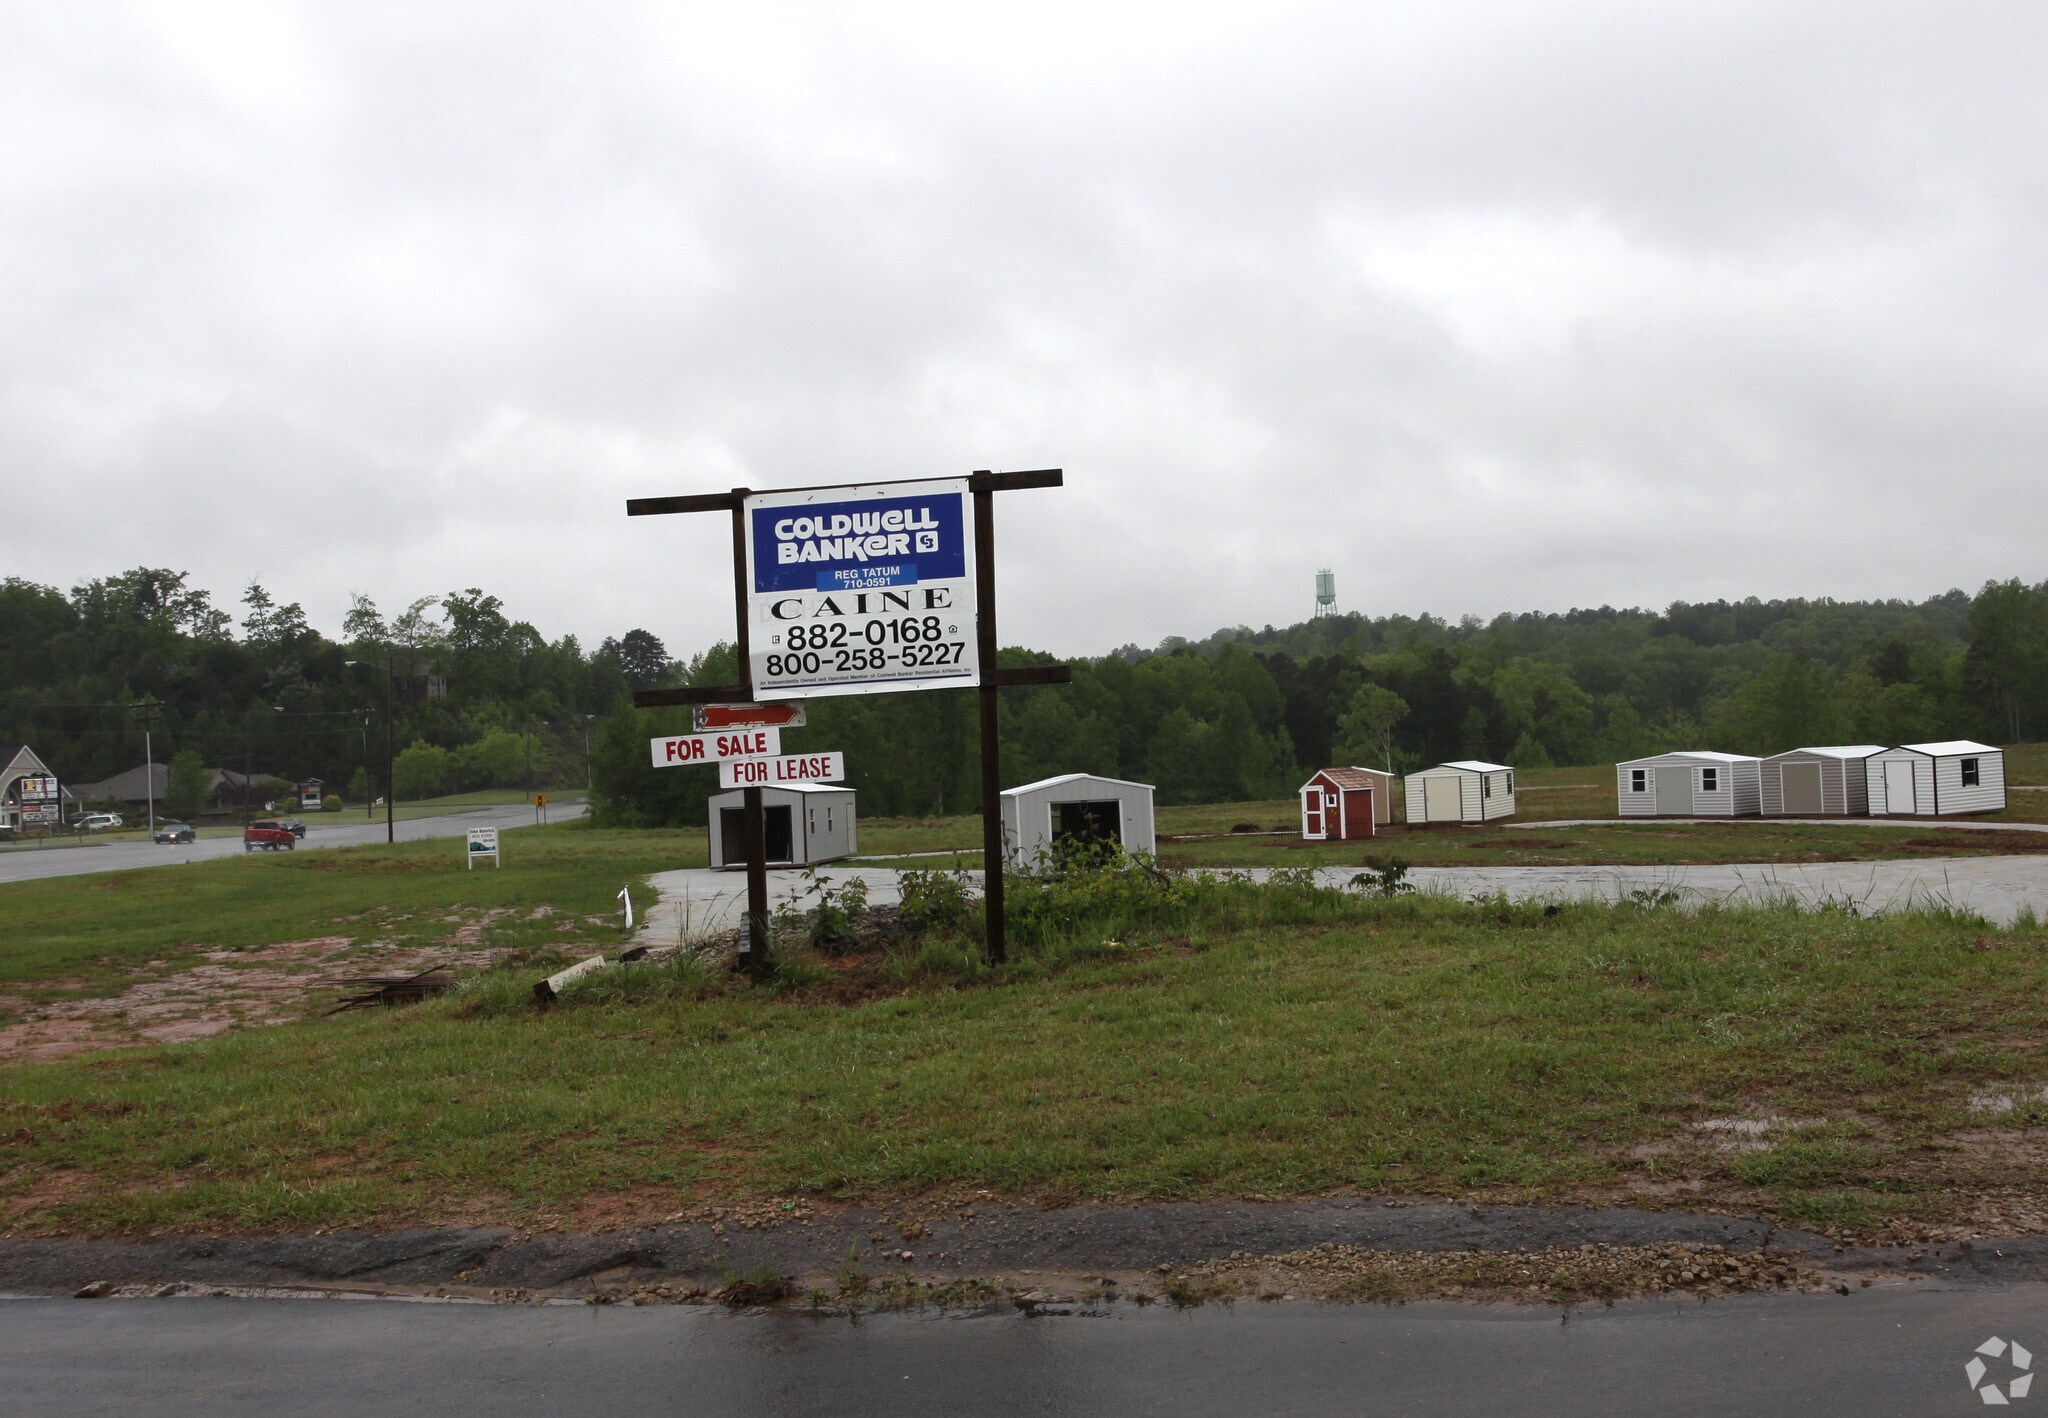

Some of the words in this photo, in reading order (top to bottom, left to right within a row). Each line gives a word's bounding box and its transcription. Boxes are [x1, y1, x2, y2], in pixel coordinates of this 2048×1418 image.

[774, 507, 940, 541] COLDWELL
[777, 533, 911, 565] BANKER
[834, 569, 859, 580] REG
[862, 566, 900, 578] TATUM
[843, 577, 891, 589] 710-0591
[770, 587, 953, 620] CAINE
[786, 615, 942, 651] 882-0168
[766, 641, 966, 677] 800-258-5227
[665, 738, 705, 762] FOR
[716, 732, 768, 757] SALE
[733, 761, 768, 783] FOR
[776, 756, 832, 781] LEASE
